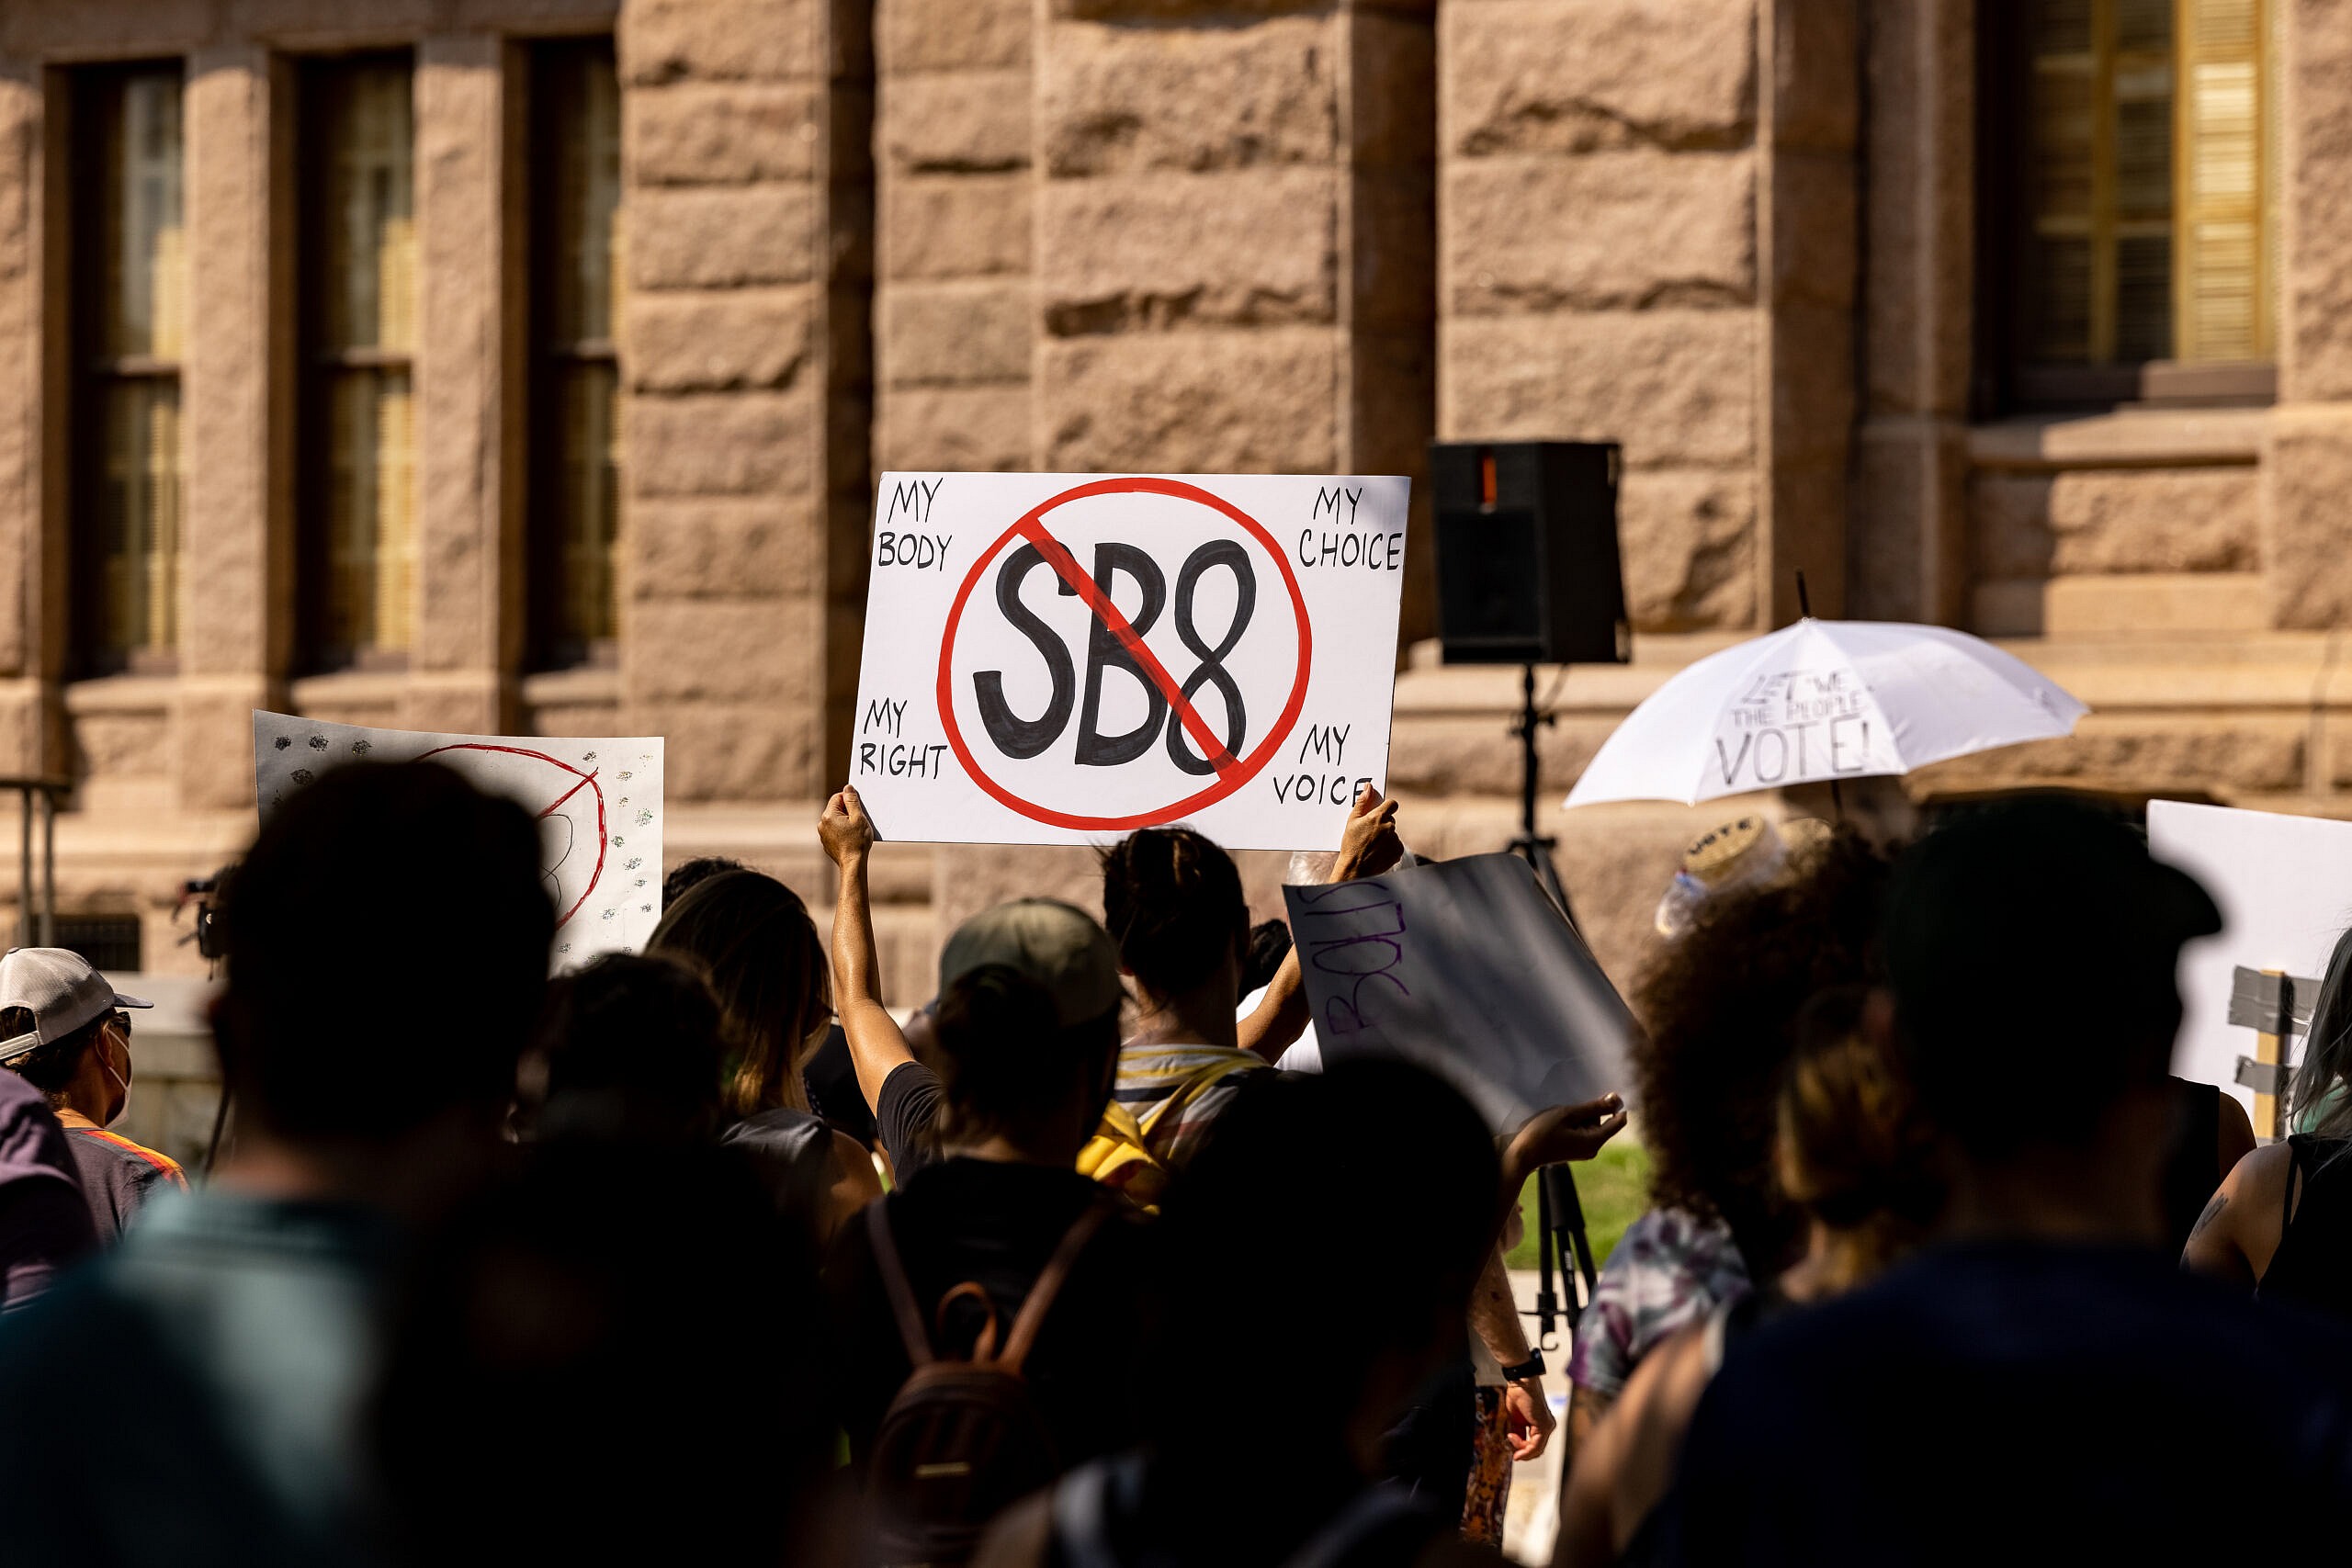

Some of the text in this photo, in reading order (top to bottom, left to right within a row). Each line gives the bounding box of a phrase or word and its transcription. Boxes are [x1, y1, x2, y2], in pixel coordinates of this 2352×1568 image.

[887, 477, 944, 524] MY
[1313, 486, 1363, 525] MY
[878, 532, 953, 572] BODY
[1299, 528, 1404, 570] CHOICE
[972, 538, 1257, 776] SB8
[1740, 669, 1813, 704] LET
[863, 697, 908, 739] MY
[1731, 690, 1868, 728] THE PEOPLE
[859, 742, 947, 779] RIGHT
[1299, 723, 1351, 766] MY
[1715, 713, 1871, 786] VOTE!
[1273, 773, 1374, 808] VOICE
